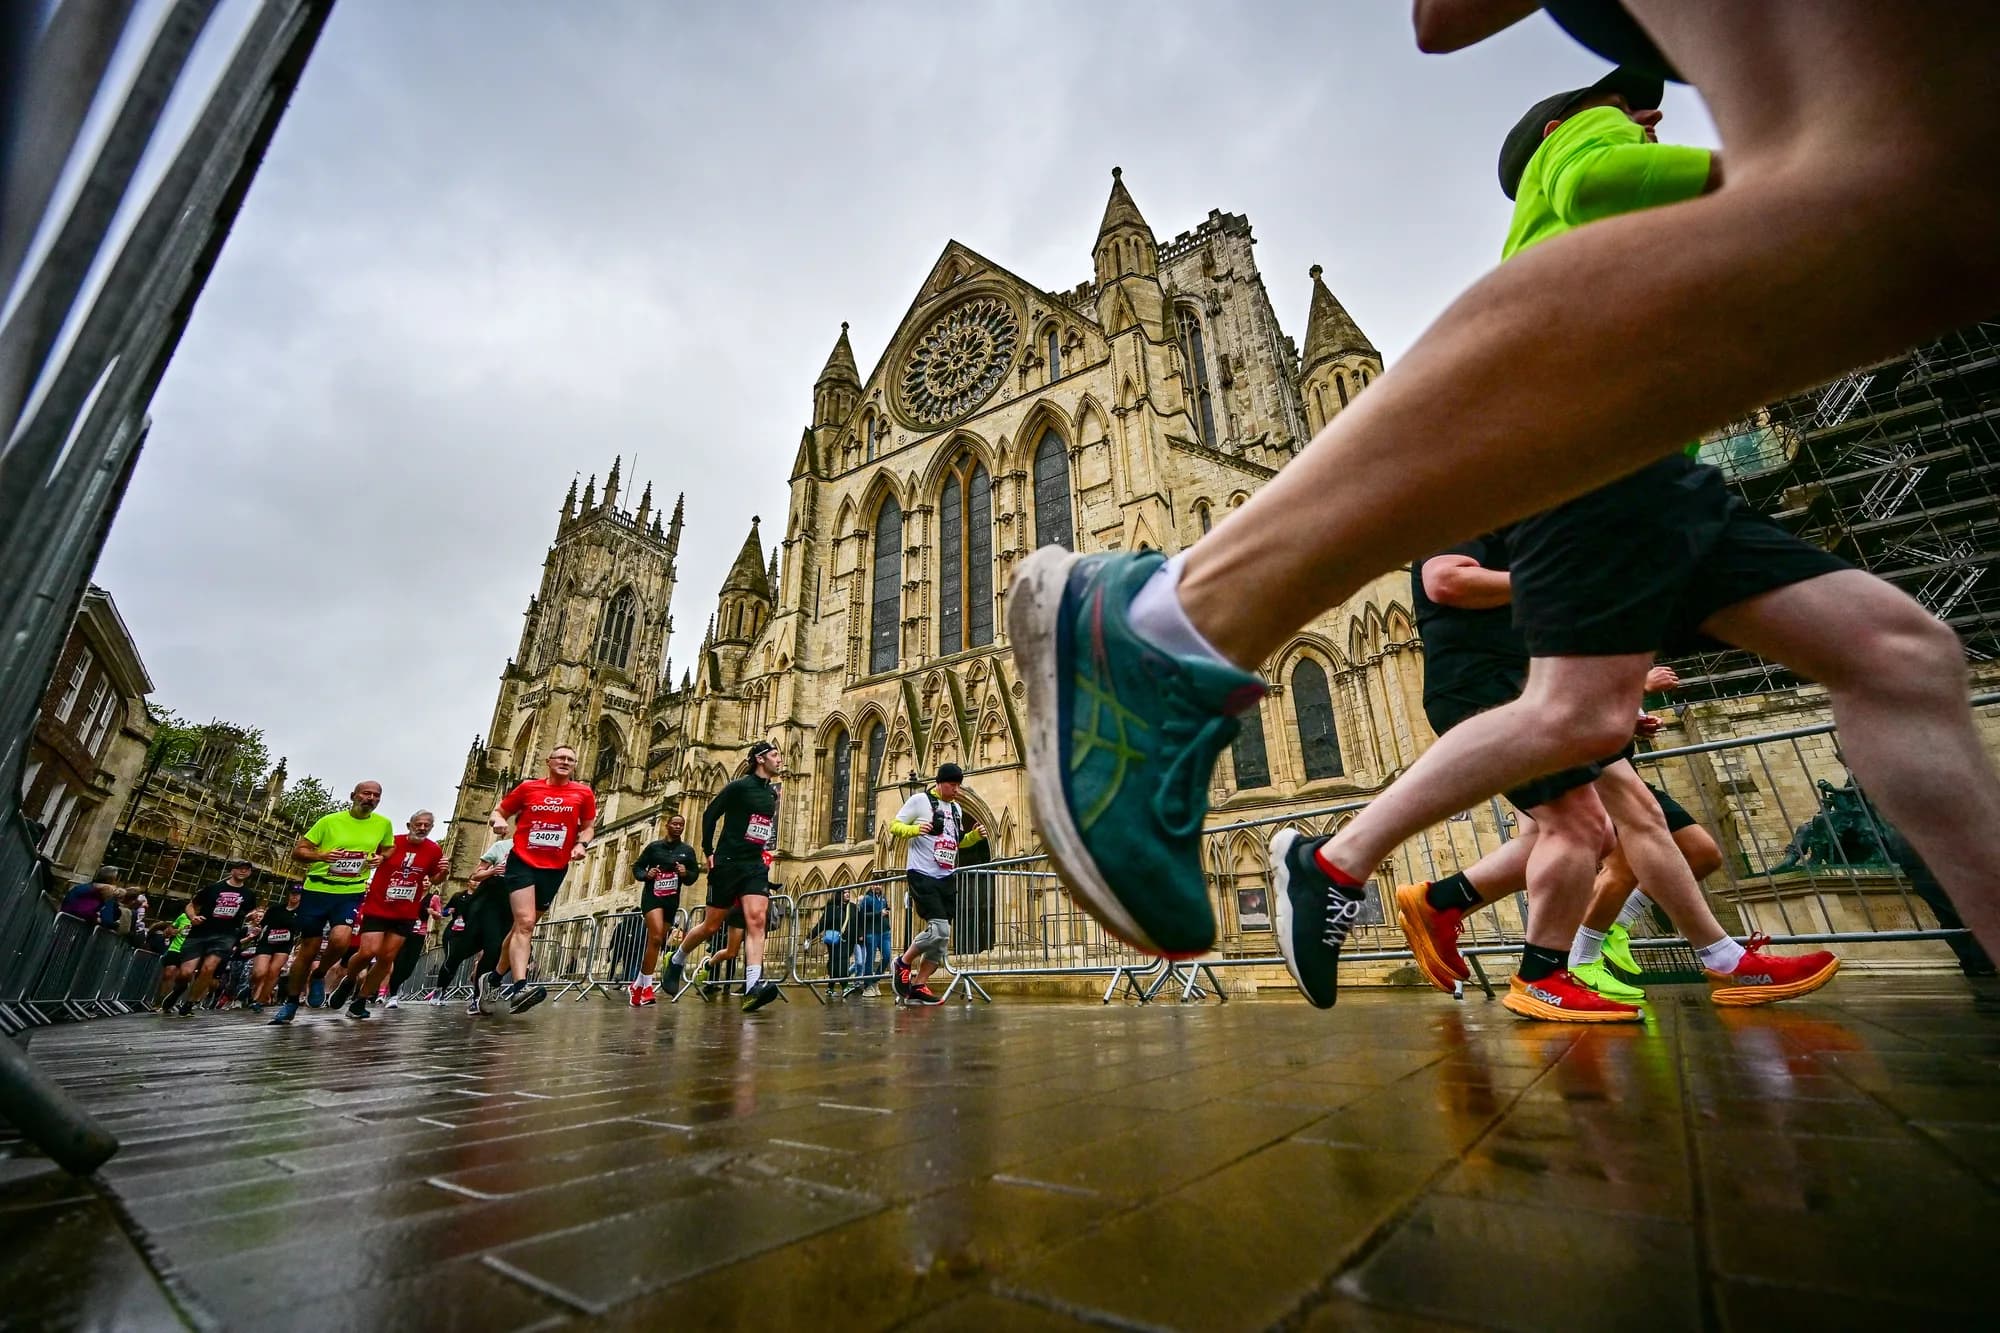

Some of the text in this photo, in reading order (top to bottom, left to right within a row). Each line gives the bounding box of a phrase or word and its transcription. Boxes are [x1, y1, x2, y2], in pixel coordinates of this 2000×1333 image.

[531, 804, 573, 813] goodgym
[535, 832, 560, 841] 24078
[336, 861, 361, 869] 20749
[1525, 983, 1563, 1007] HOKA
